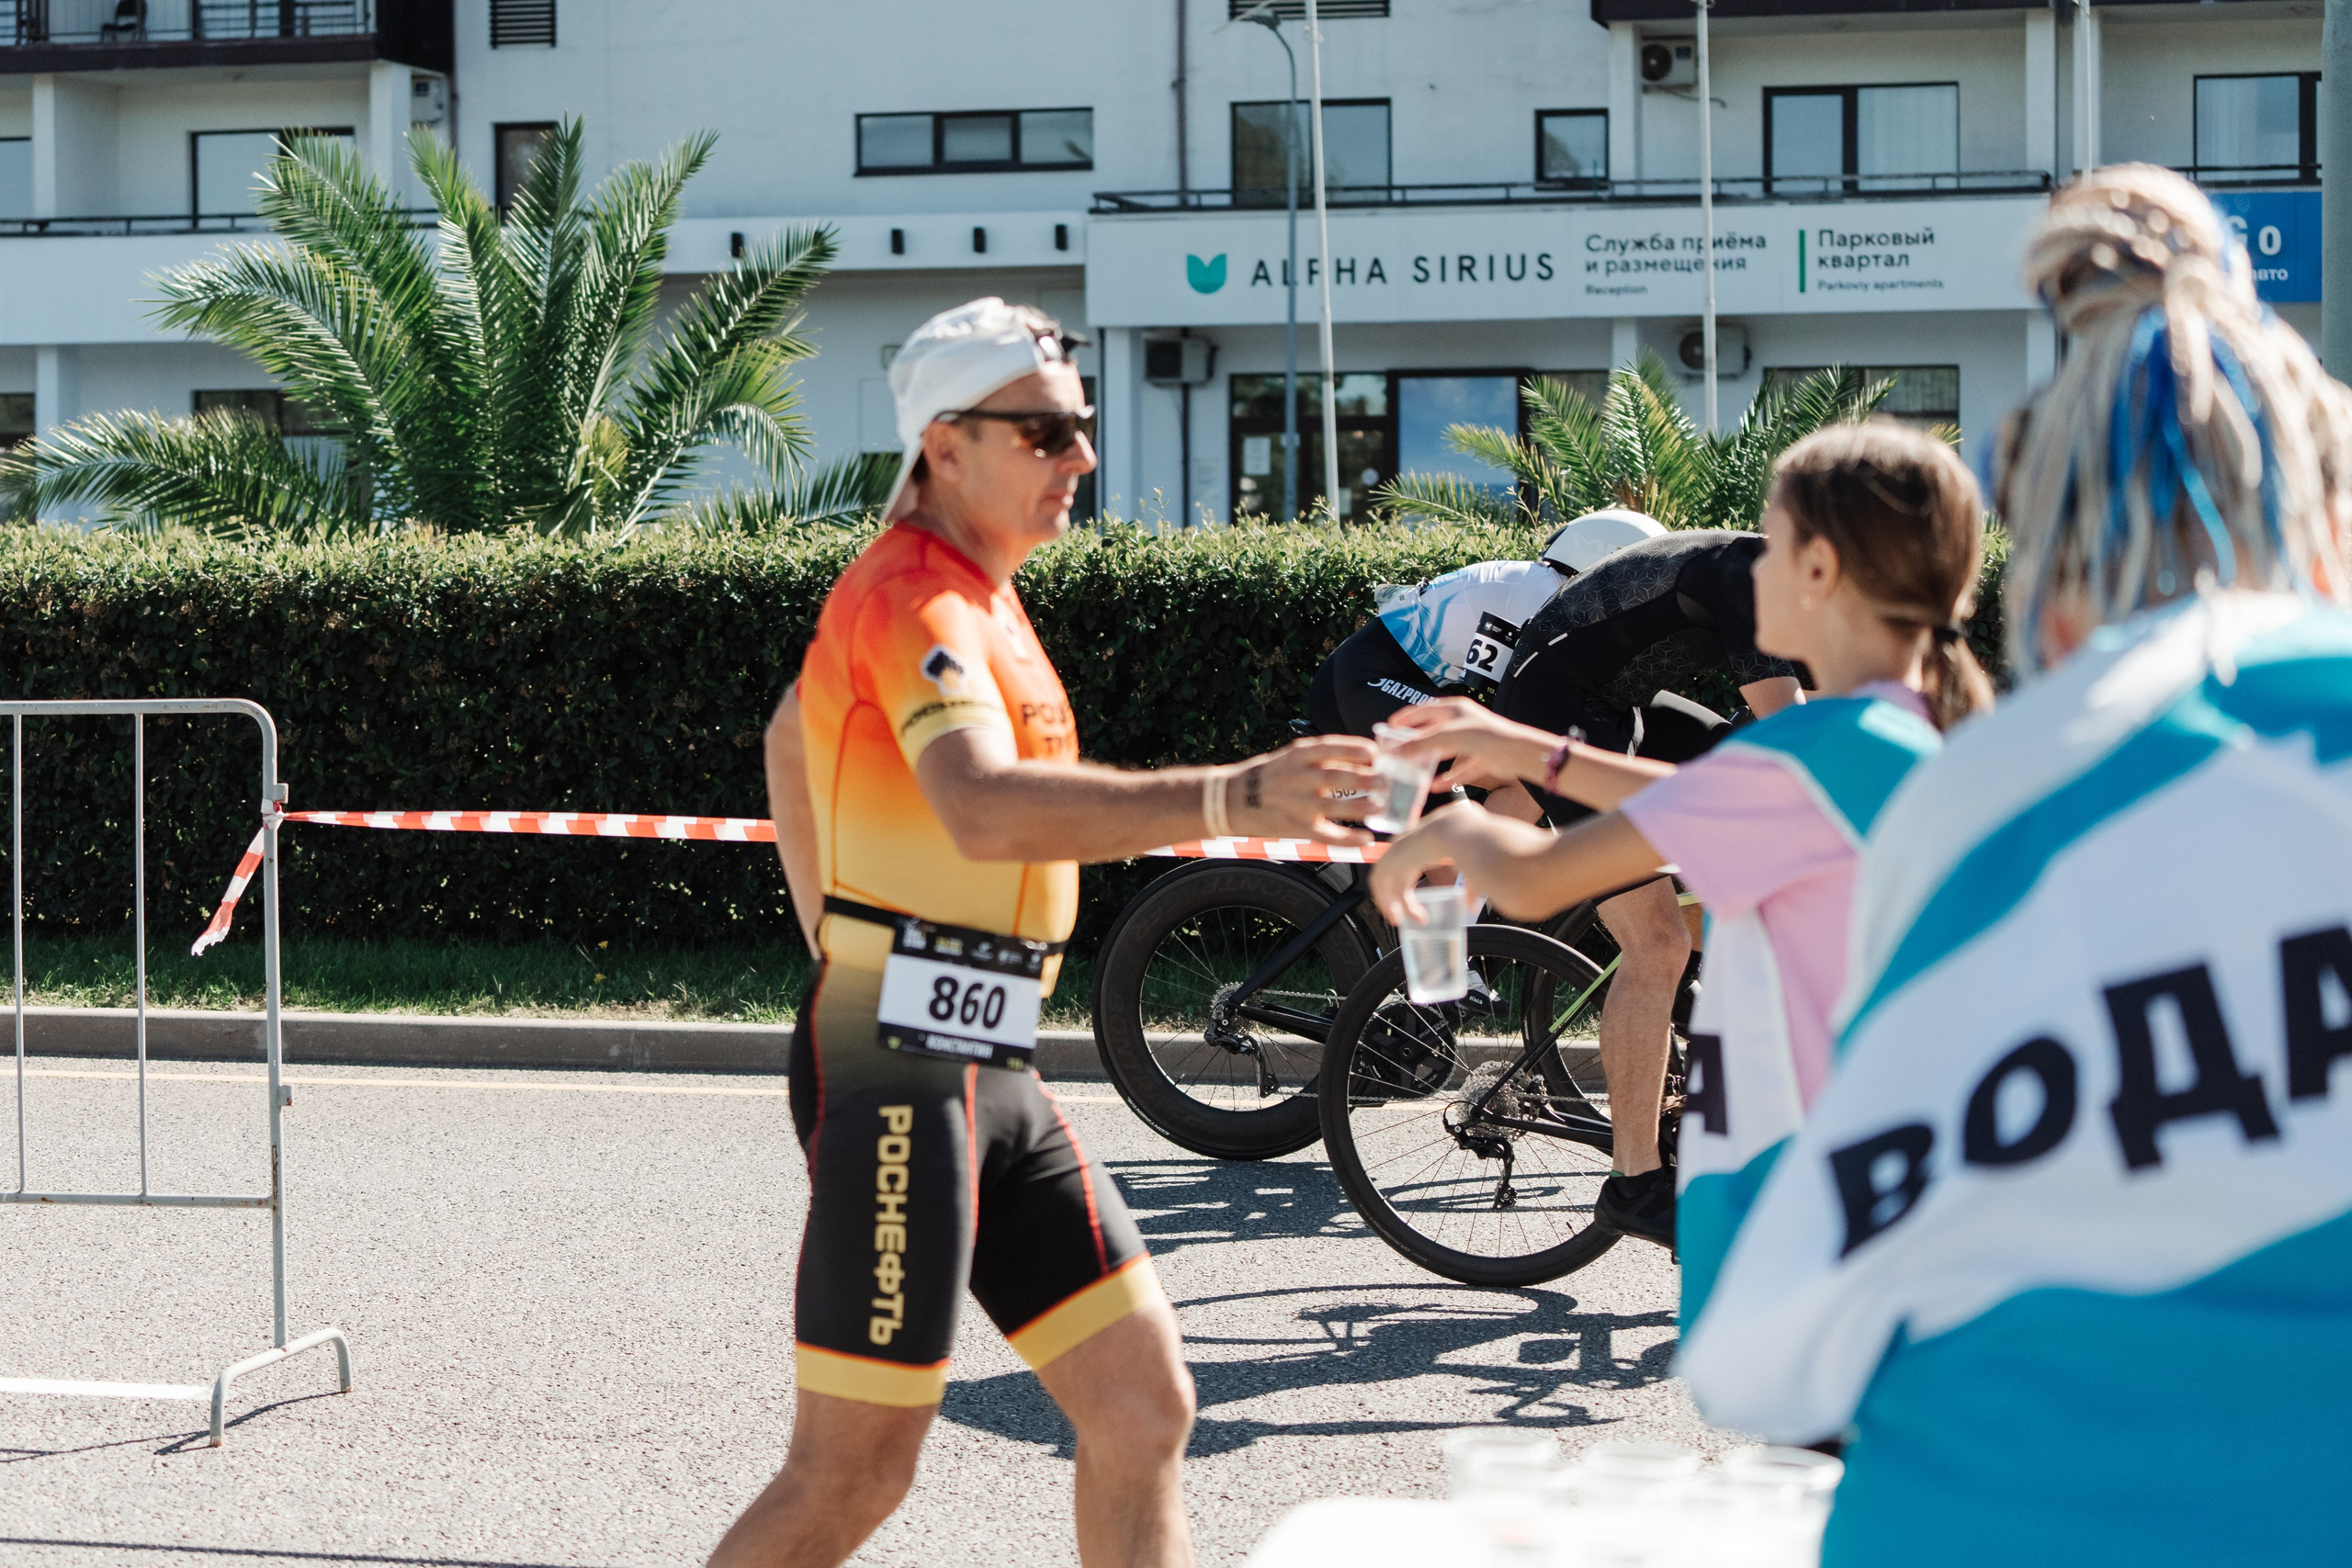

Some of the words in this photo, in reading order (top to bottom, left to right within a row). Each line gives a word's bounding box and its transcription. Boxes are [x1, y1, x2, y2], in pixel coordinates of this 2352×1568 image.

[1586, 232, 1675, 256] Служба
[1682, 231, 1767, 255] приёма
[1818, 226, 1934, 251] Парковый
[1250, 257, 1387, 287] ALPHA
[1413, 253, 1555, 284] SIRIUS
[1586, 260, 1598, 273] и
[1818, 254, 1910, 273] квартал
[1586, 283, 1648, 296] Reception
[1466, 639, 1498, 672] 62
[929, 976, 1005, 1029] 860
[1126, 1096, 1170, 1136] CONTINENTAL
[868, 1104, 914, 1347] РОСНЕФТЬ
